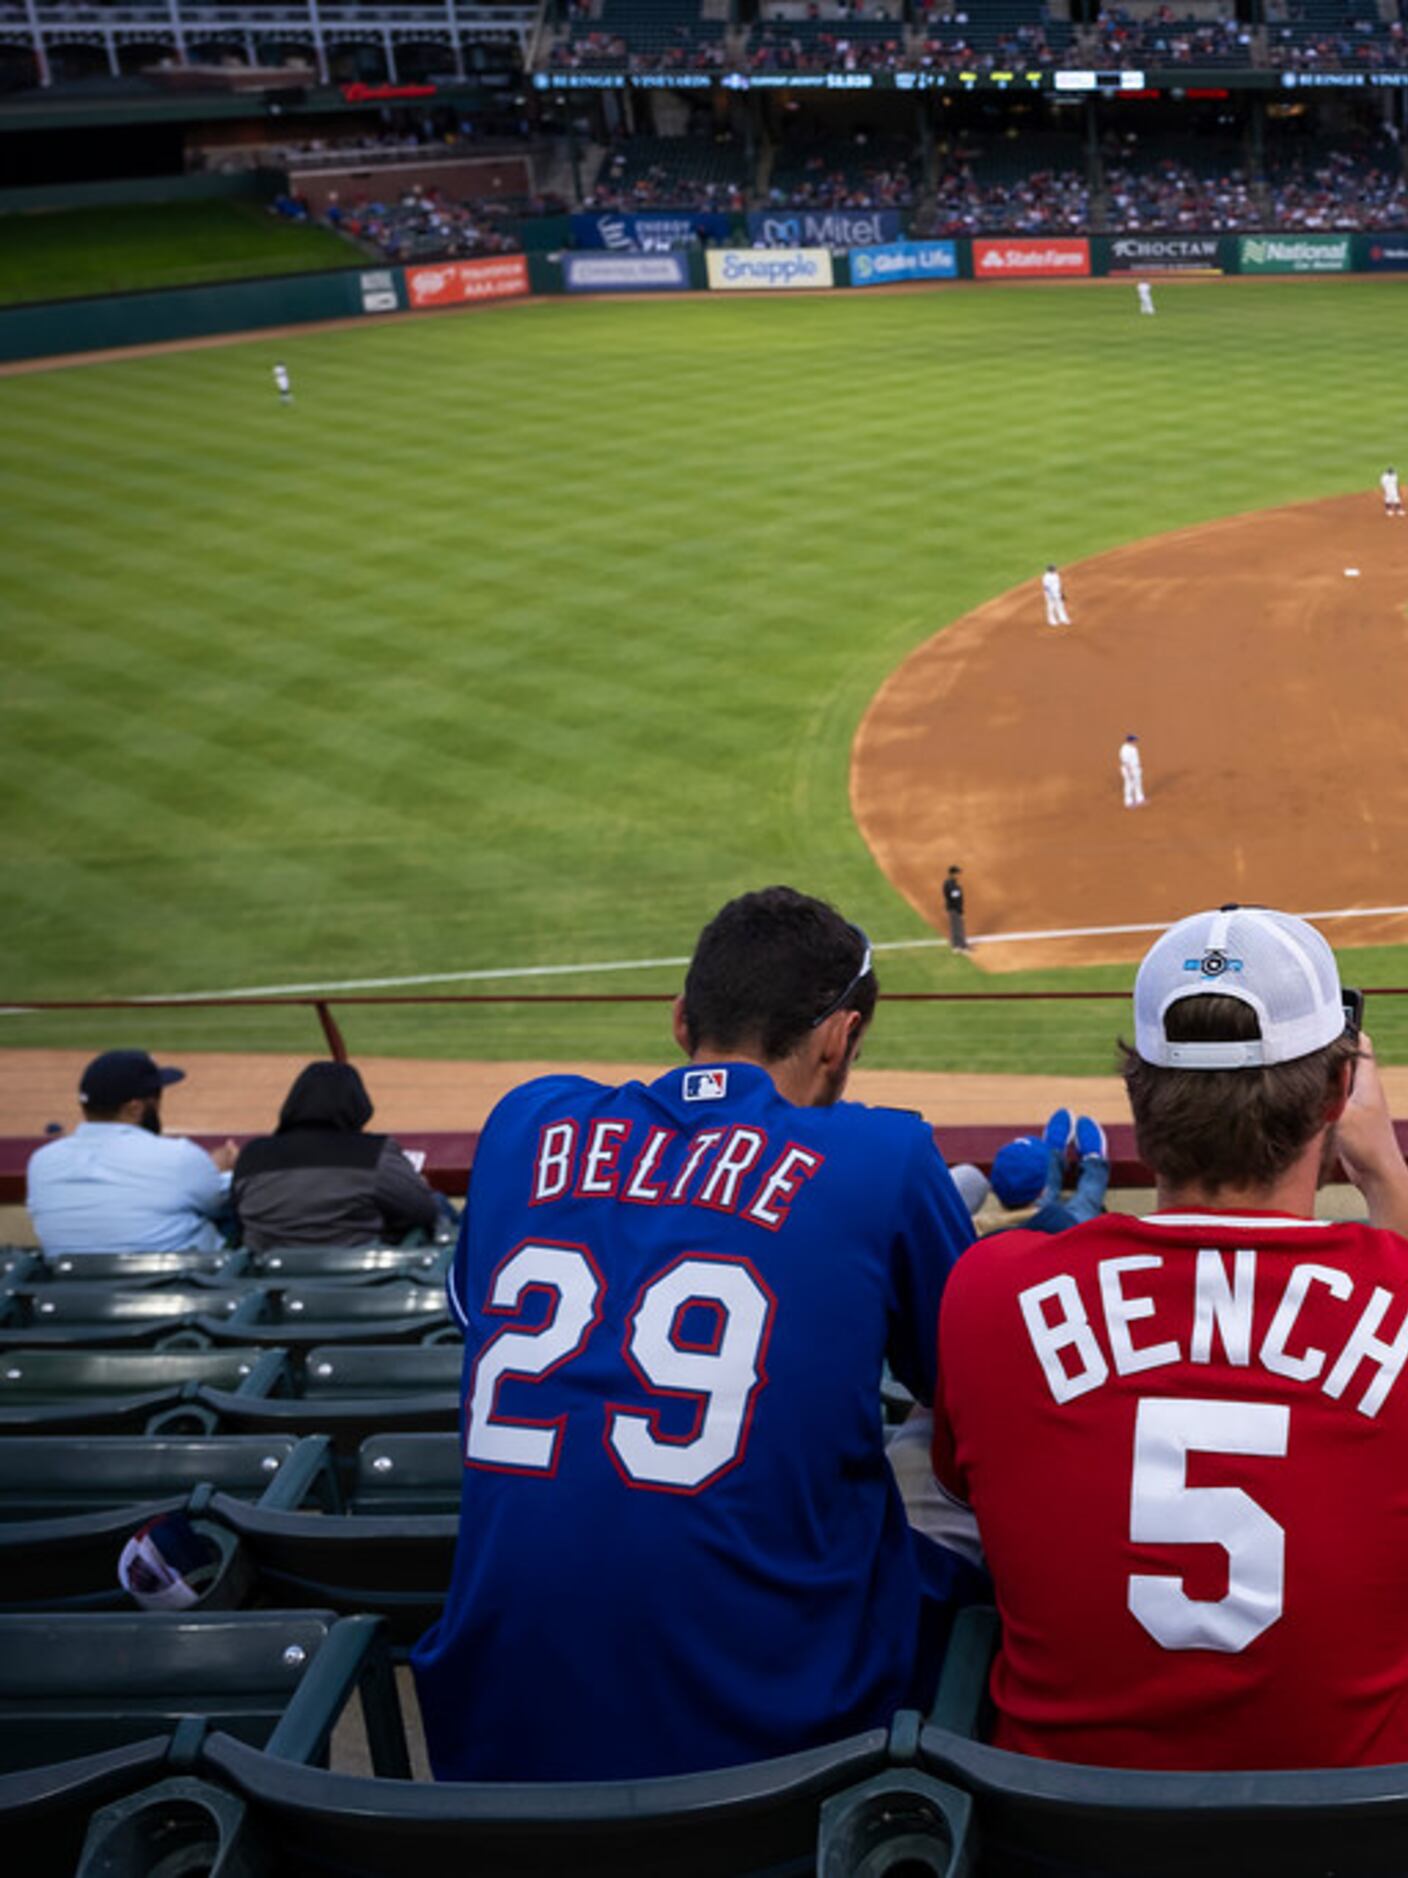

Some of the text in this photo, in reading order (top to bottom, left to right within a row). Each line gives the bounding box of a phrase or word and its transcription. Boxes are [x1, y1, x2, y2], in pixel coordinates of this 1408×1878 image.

[805, 214, 884, 245] Mitel
[1121, 240, 1218, 257] CHOCTAW
[1265, 241, 1347, 261] National
[722, 254, 818, 281] Snapple
[528, 1118, 825, 1232] BELTRE
[464, 1237, 778, 1496] 29
[1127, 1397, 1291, 1653] 5
